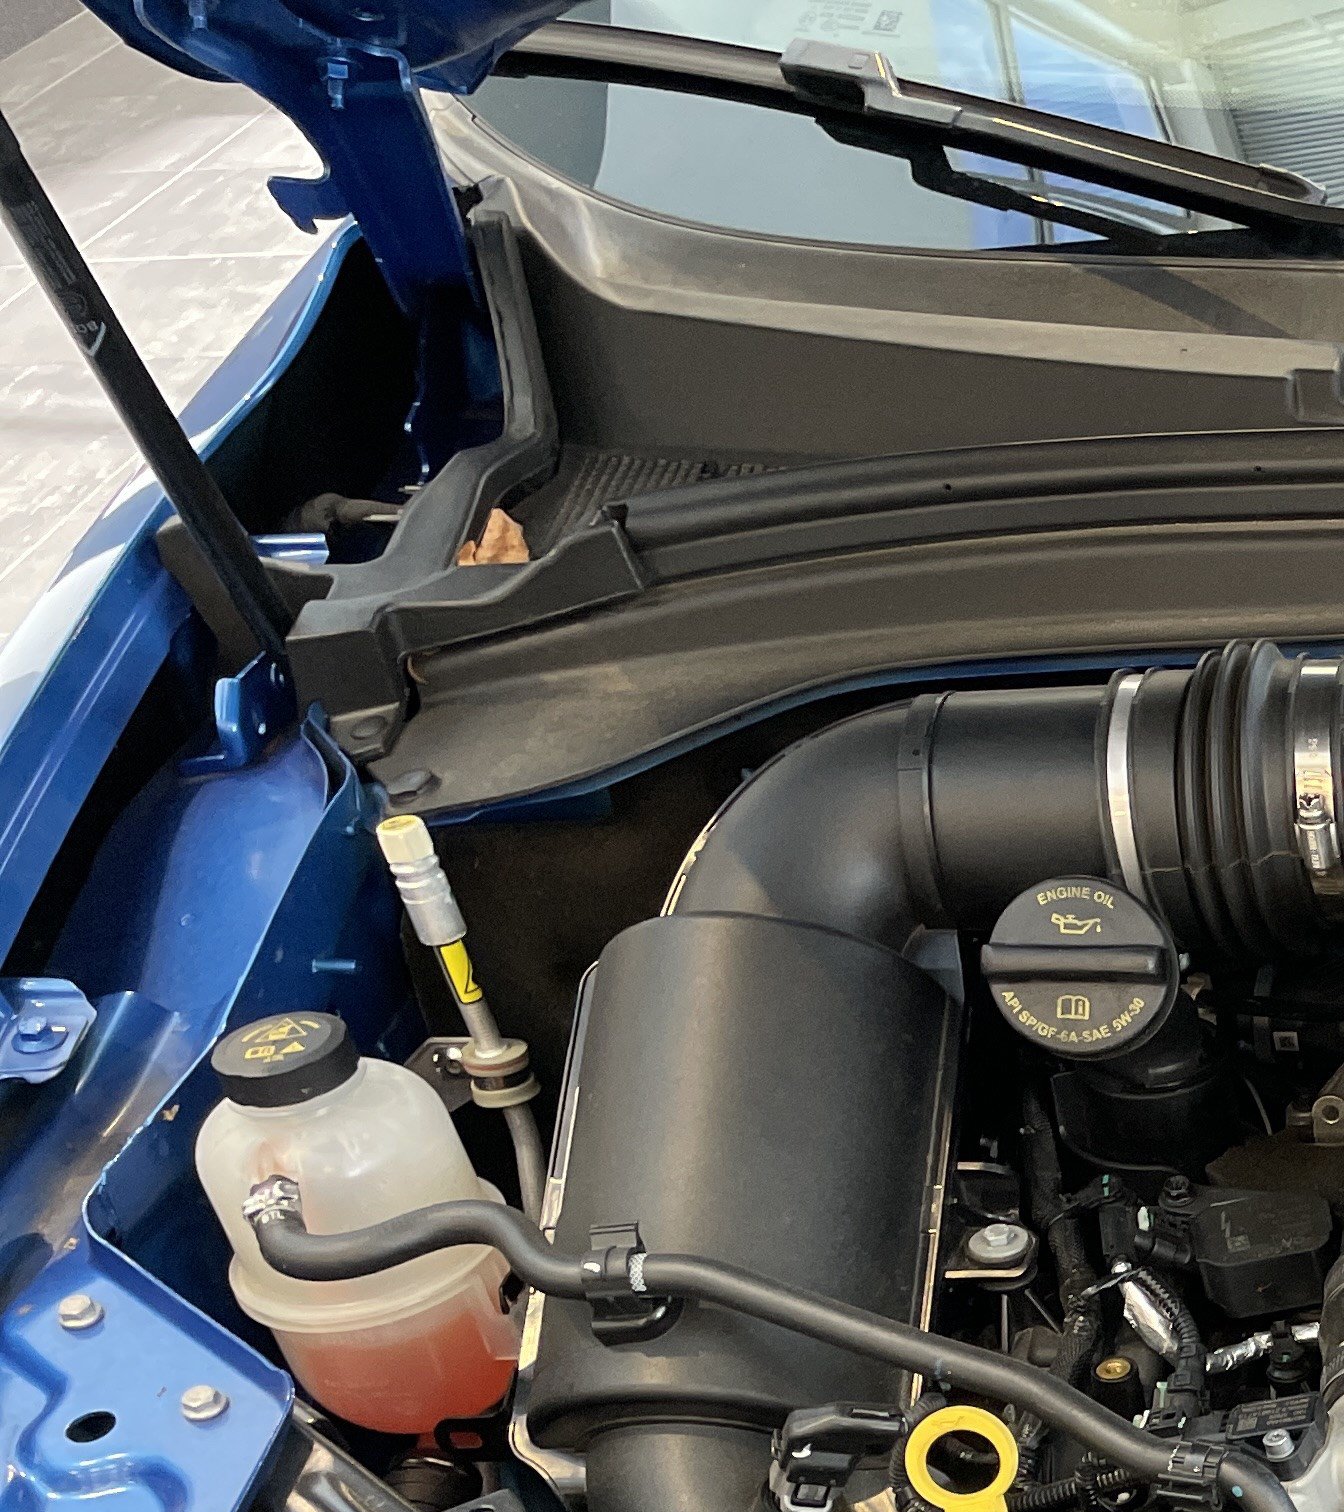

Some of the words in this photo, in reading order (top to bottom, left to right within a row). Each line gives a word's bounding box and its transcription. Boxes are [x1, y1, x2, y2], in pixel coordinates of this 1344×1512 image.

[1036, 886, 1092, 906] ENGINE
[1093, 890, 1115, 909] OIL
[1001, 991, 1023, 1014] API
[1112, 997, 1145, 1032] 5W-30
